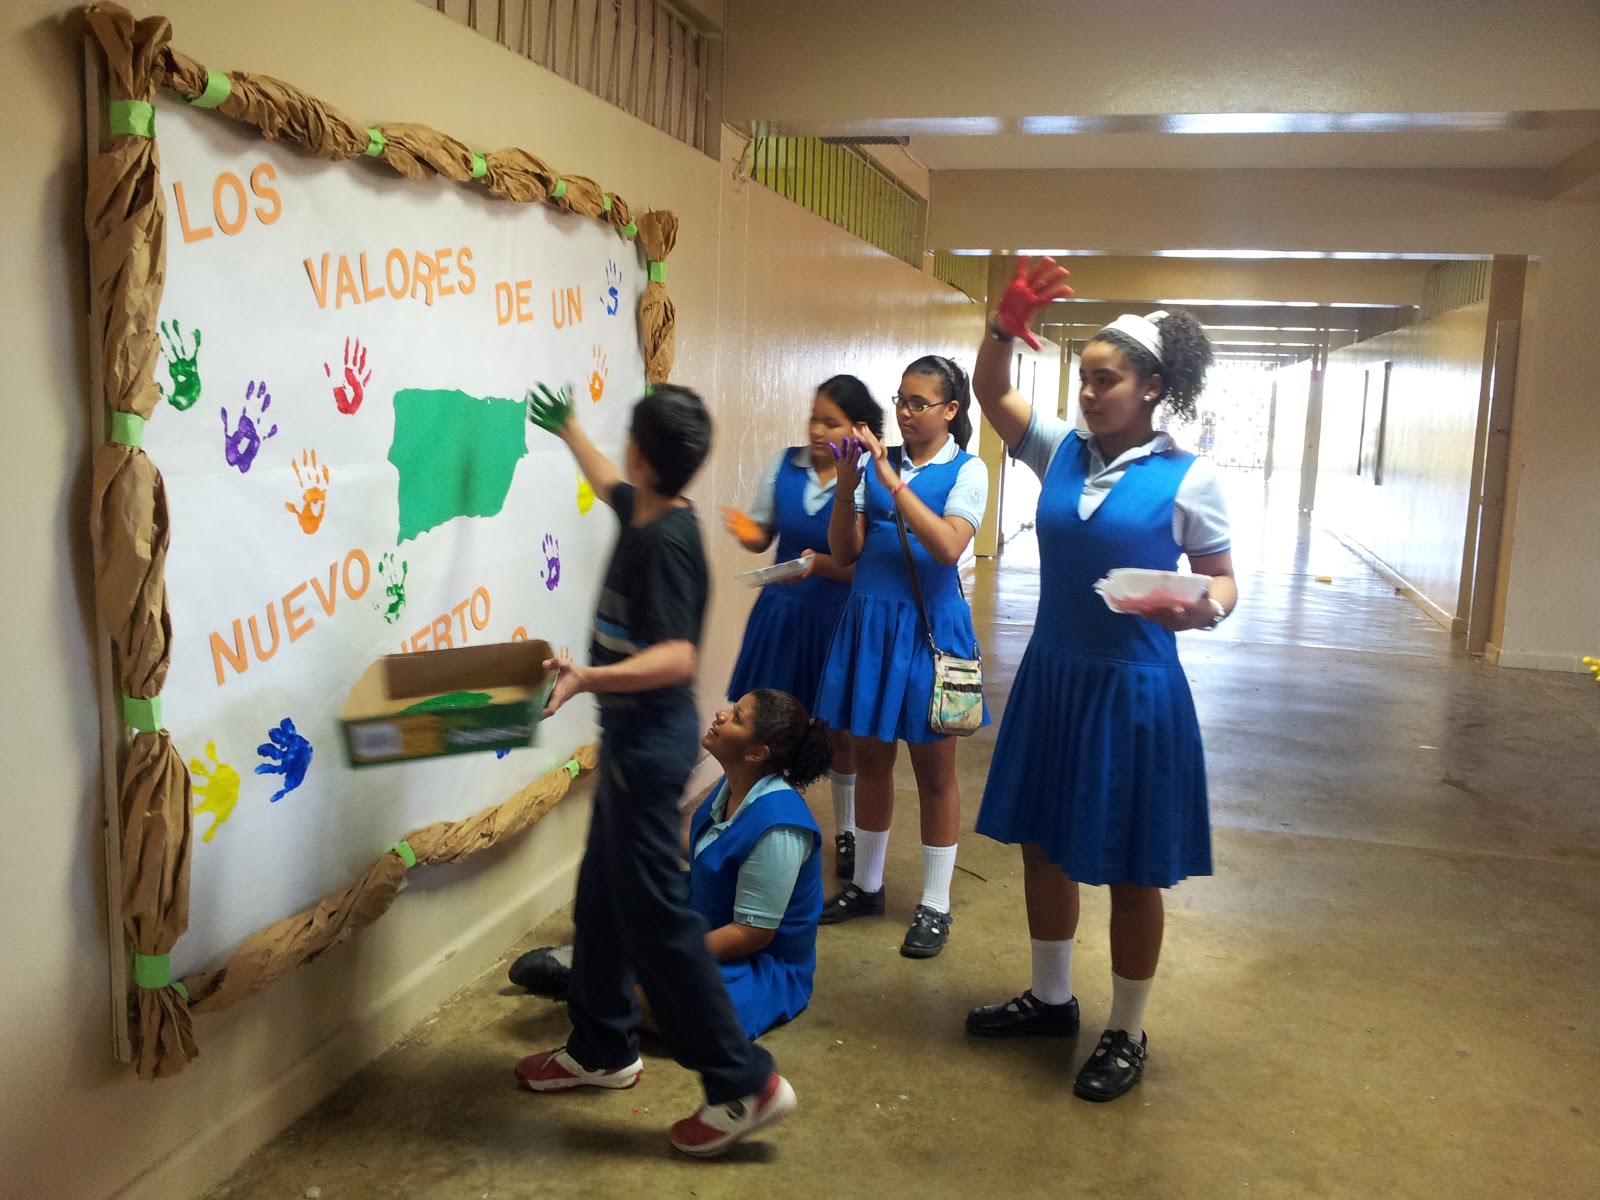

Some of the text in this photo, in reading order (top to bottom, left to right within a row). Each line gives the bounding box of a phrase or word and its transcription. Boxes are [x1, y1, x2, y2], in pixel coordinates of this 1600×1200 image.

[173, 162, 282, 244] LOS
[303, 247, 583, 329] VALORES DE UN
[209, 549, 371, 686] NUEVO
